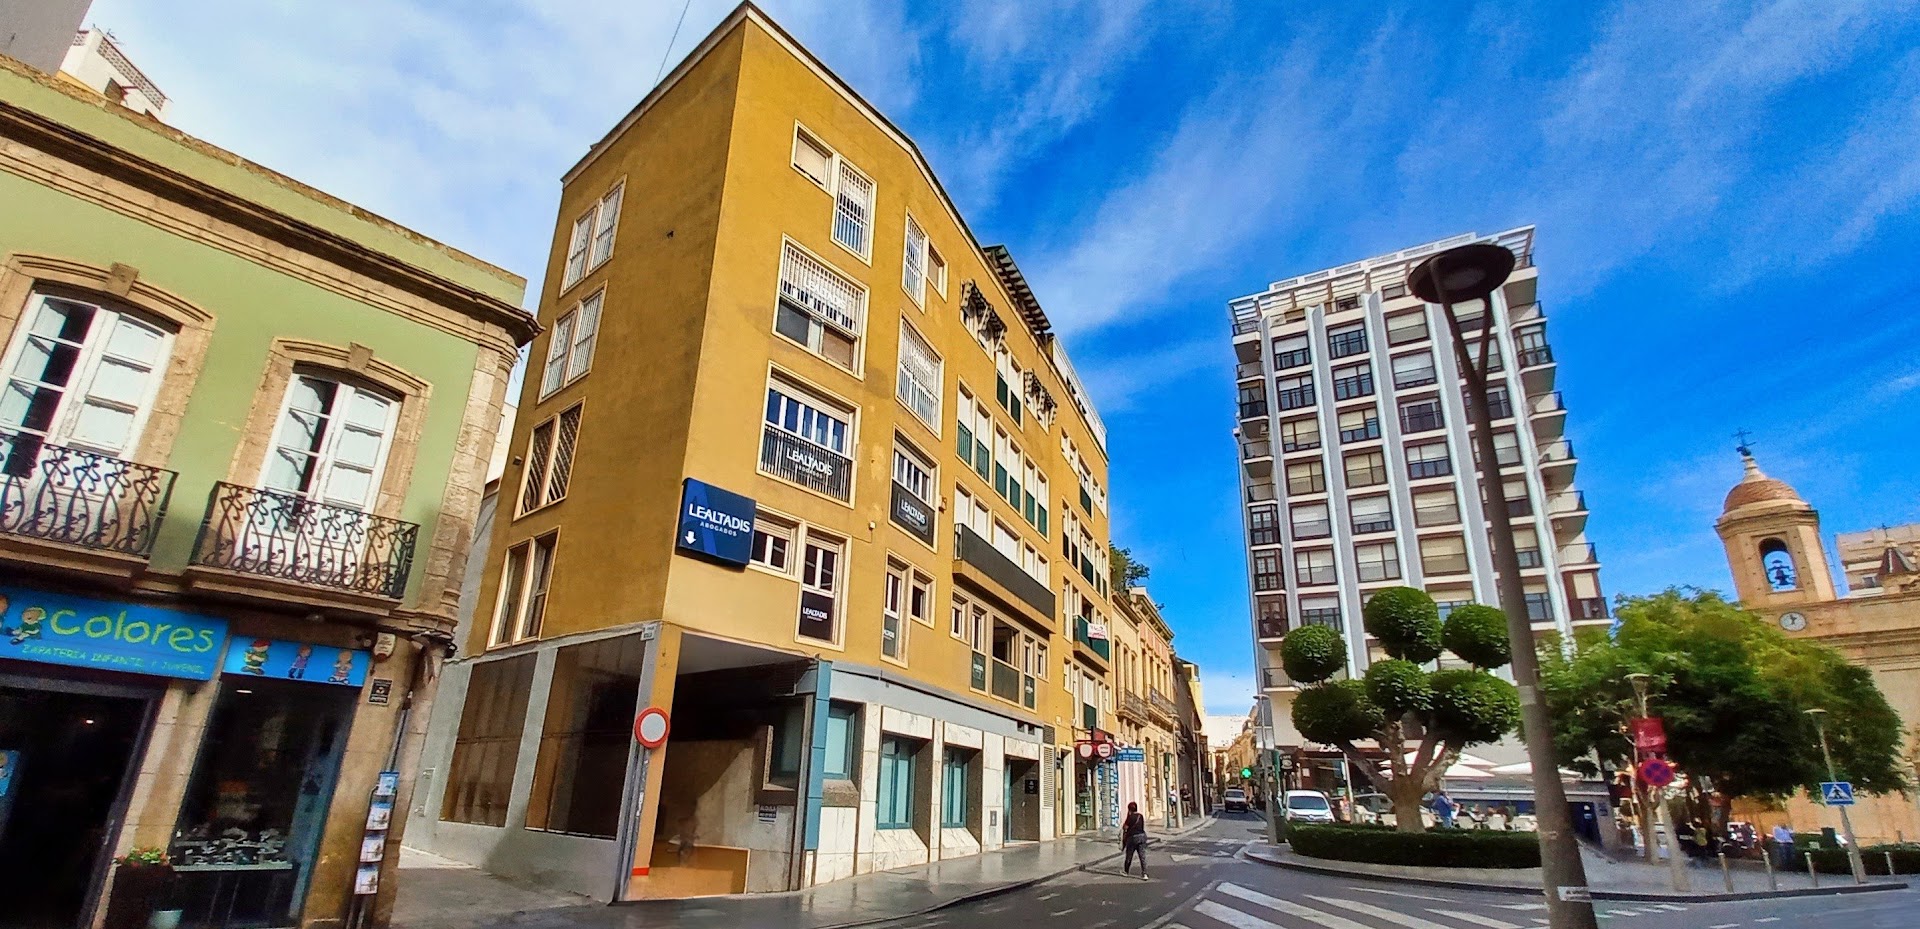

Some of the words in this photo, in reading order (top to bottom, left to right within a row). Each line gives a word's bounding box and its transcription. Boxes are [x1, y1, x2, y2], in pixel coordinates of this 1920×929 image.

[786, 447, 833, 476] LEALTADIS
[688, 503, 751, 533] LEALTADIS
[699, 521, 738, 537] ABOGADOS
[802, 606, 828, 620] LEALTADIS
[50, 609, 214, 652] Colores
